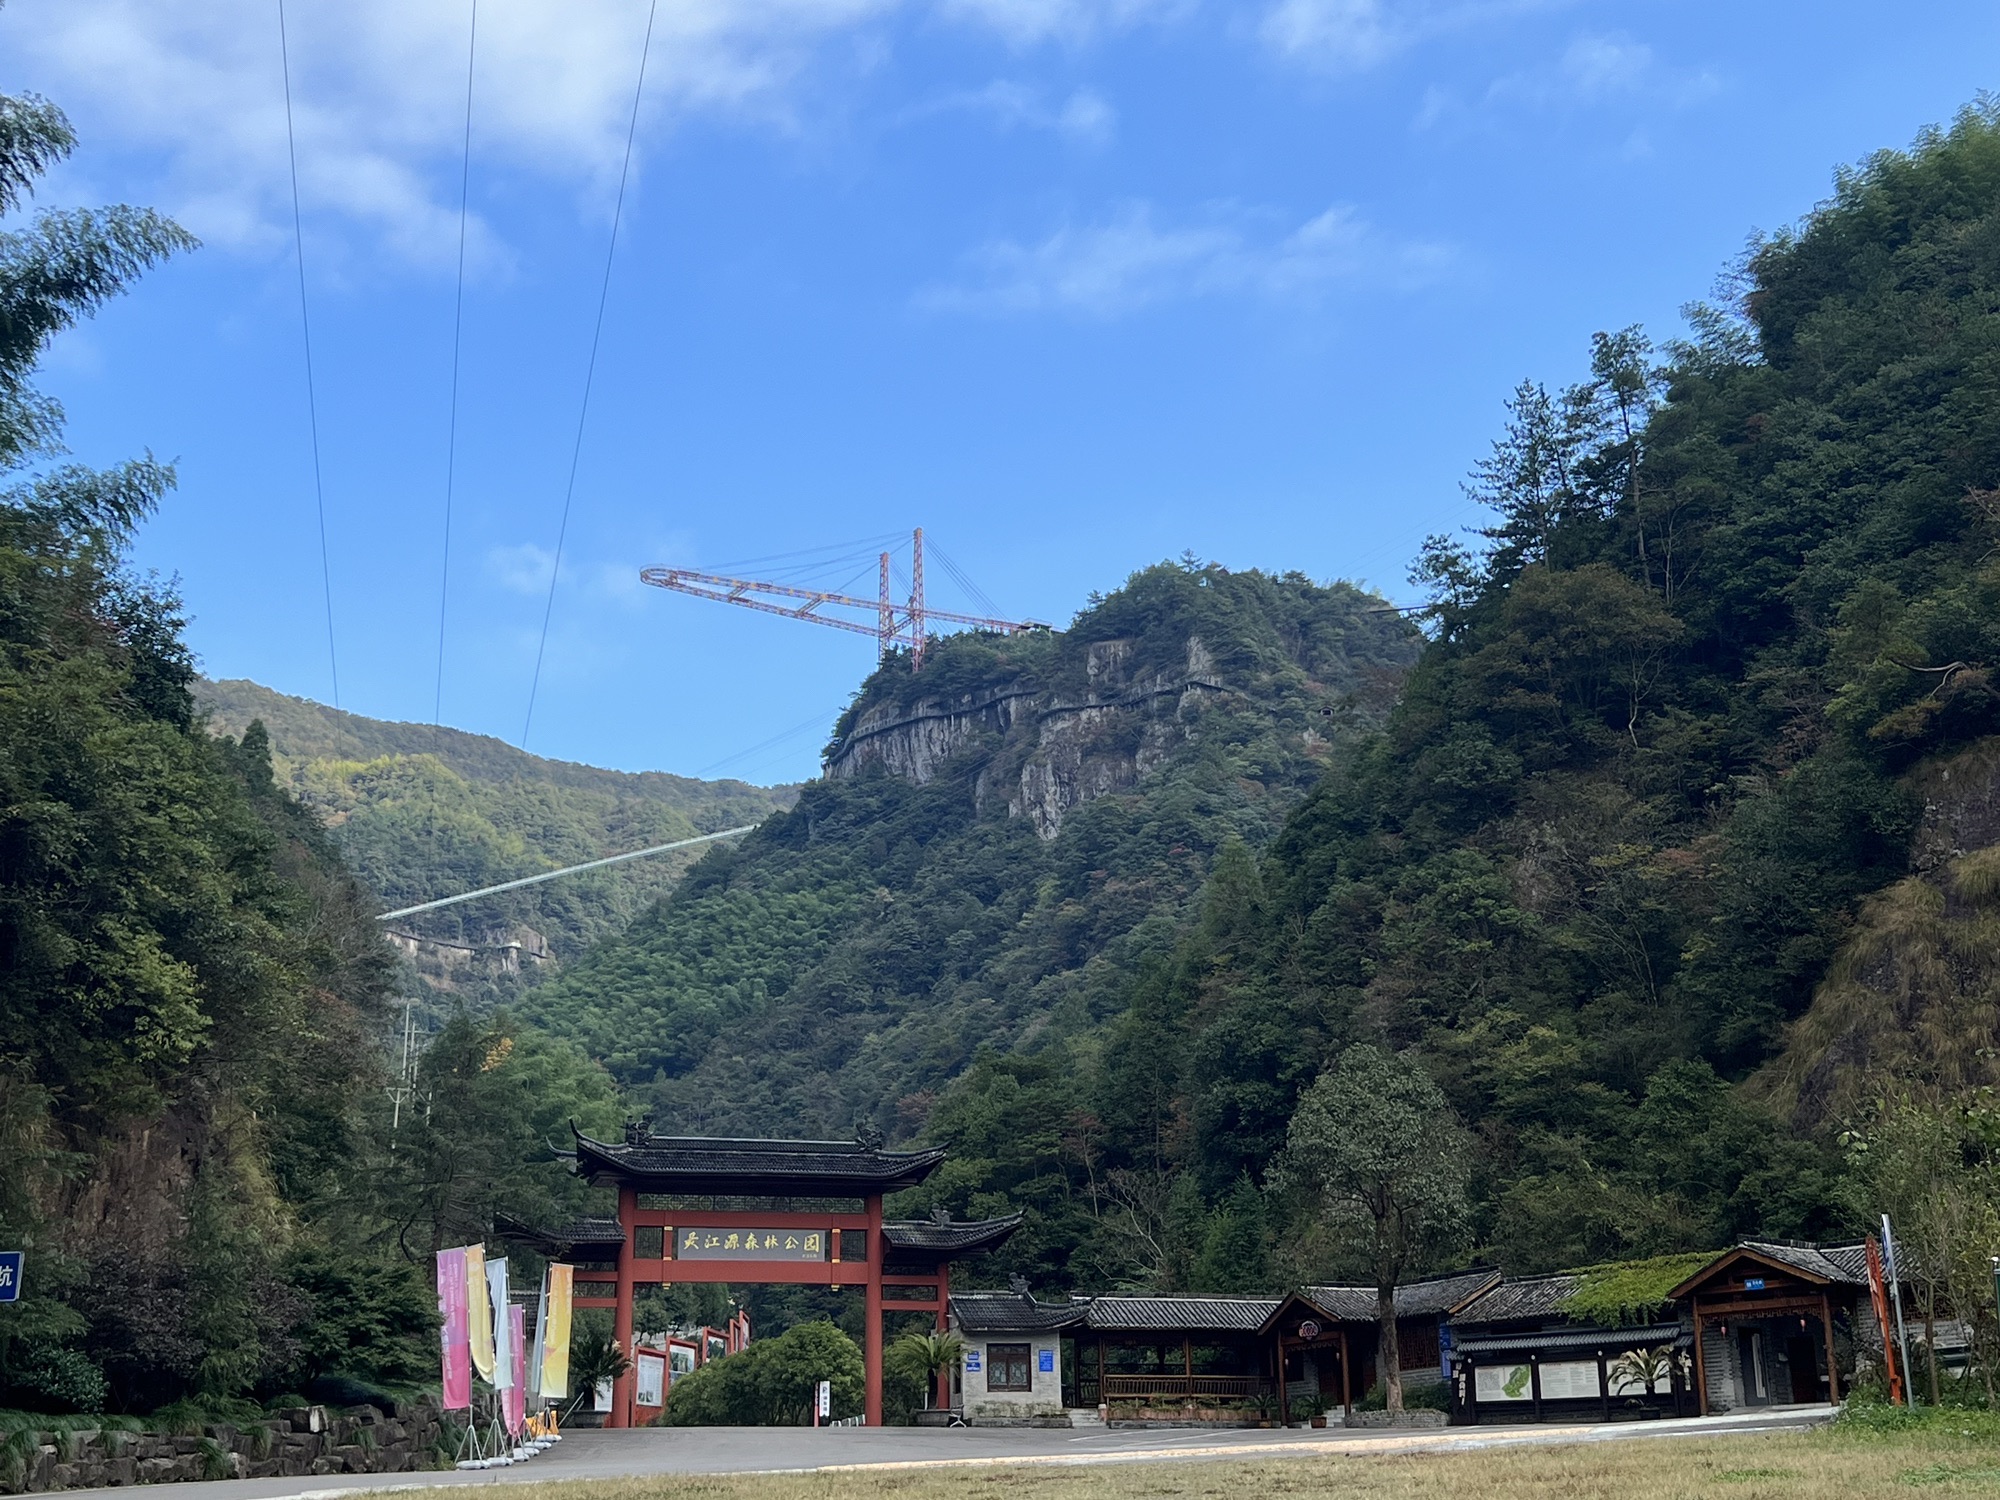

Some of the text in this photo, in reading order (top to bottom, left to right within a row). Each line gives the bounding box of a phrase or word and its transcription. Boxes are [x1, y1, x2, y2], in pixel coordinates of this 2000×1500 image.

[683, 1231, 820, 1252] 灵江源森林公园
